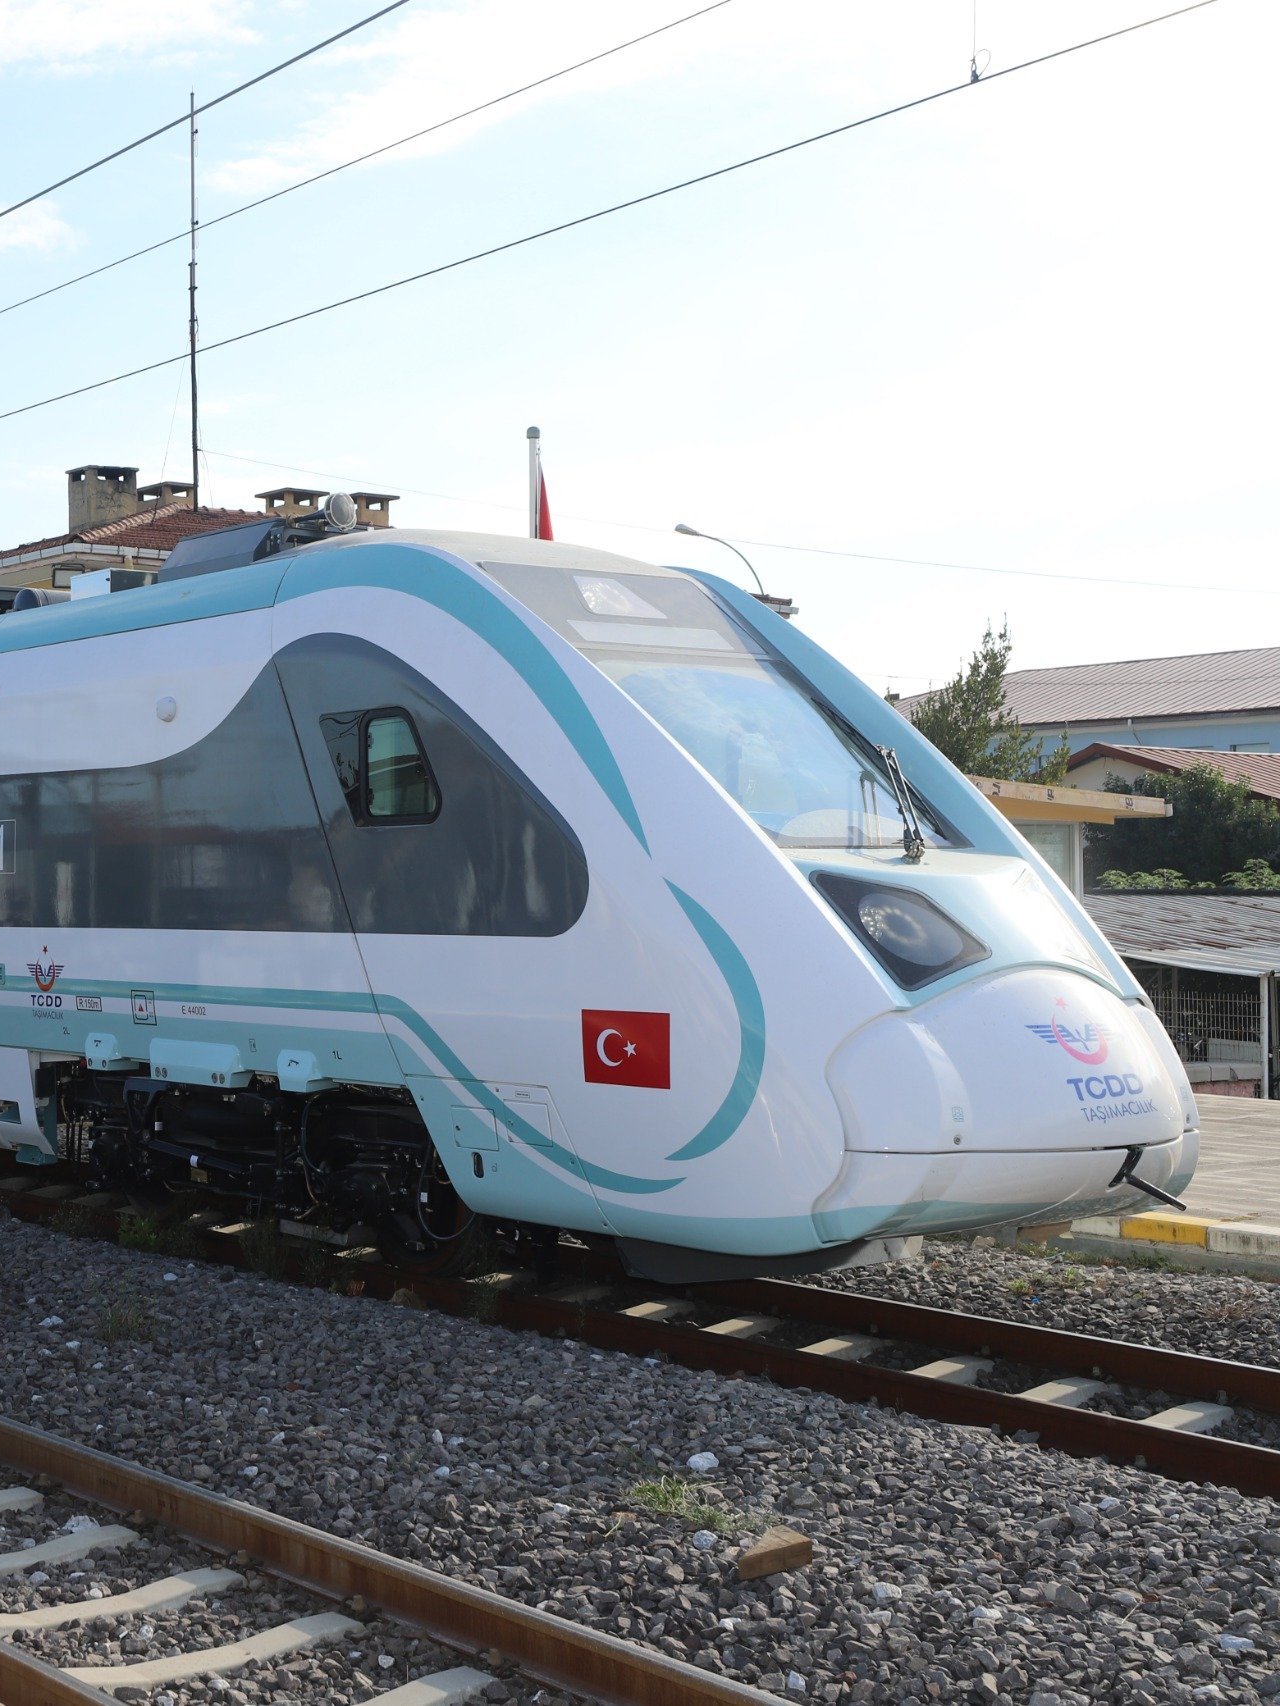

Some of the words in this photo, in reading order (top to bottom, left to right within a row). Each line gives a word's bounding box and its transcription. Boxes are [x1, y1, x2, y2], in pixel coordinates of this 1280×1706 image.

[30, 994, 63, 1008] TCDD
[78, 998, 84, 1008] R
[85, 998, 100, 1010] 150m
[32, 1009, 65, 1021] TAŞIMACILIK
[181, 1005, 187, 1015] E
[188, 1006, 207, 1016] 44002
[62, 1026, 71, 1035] 2L
[332, 1050, 343, 1060] 1L
[1066, 1073, 1144, 1102] TCDD
[1080, 1098, 1158, 1124] TAŞIMACILIK
